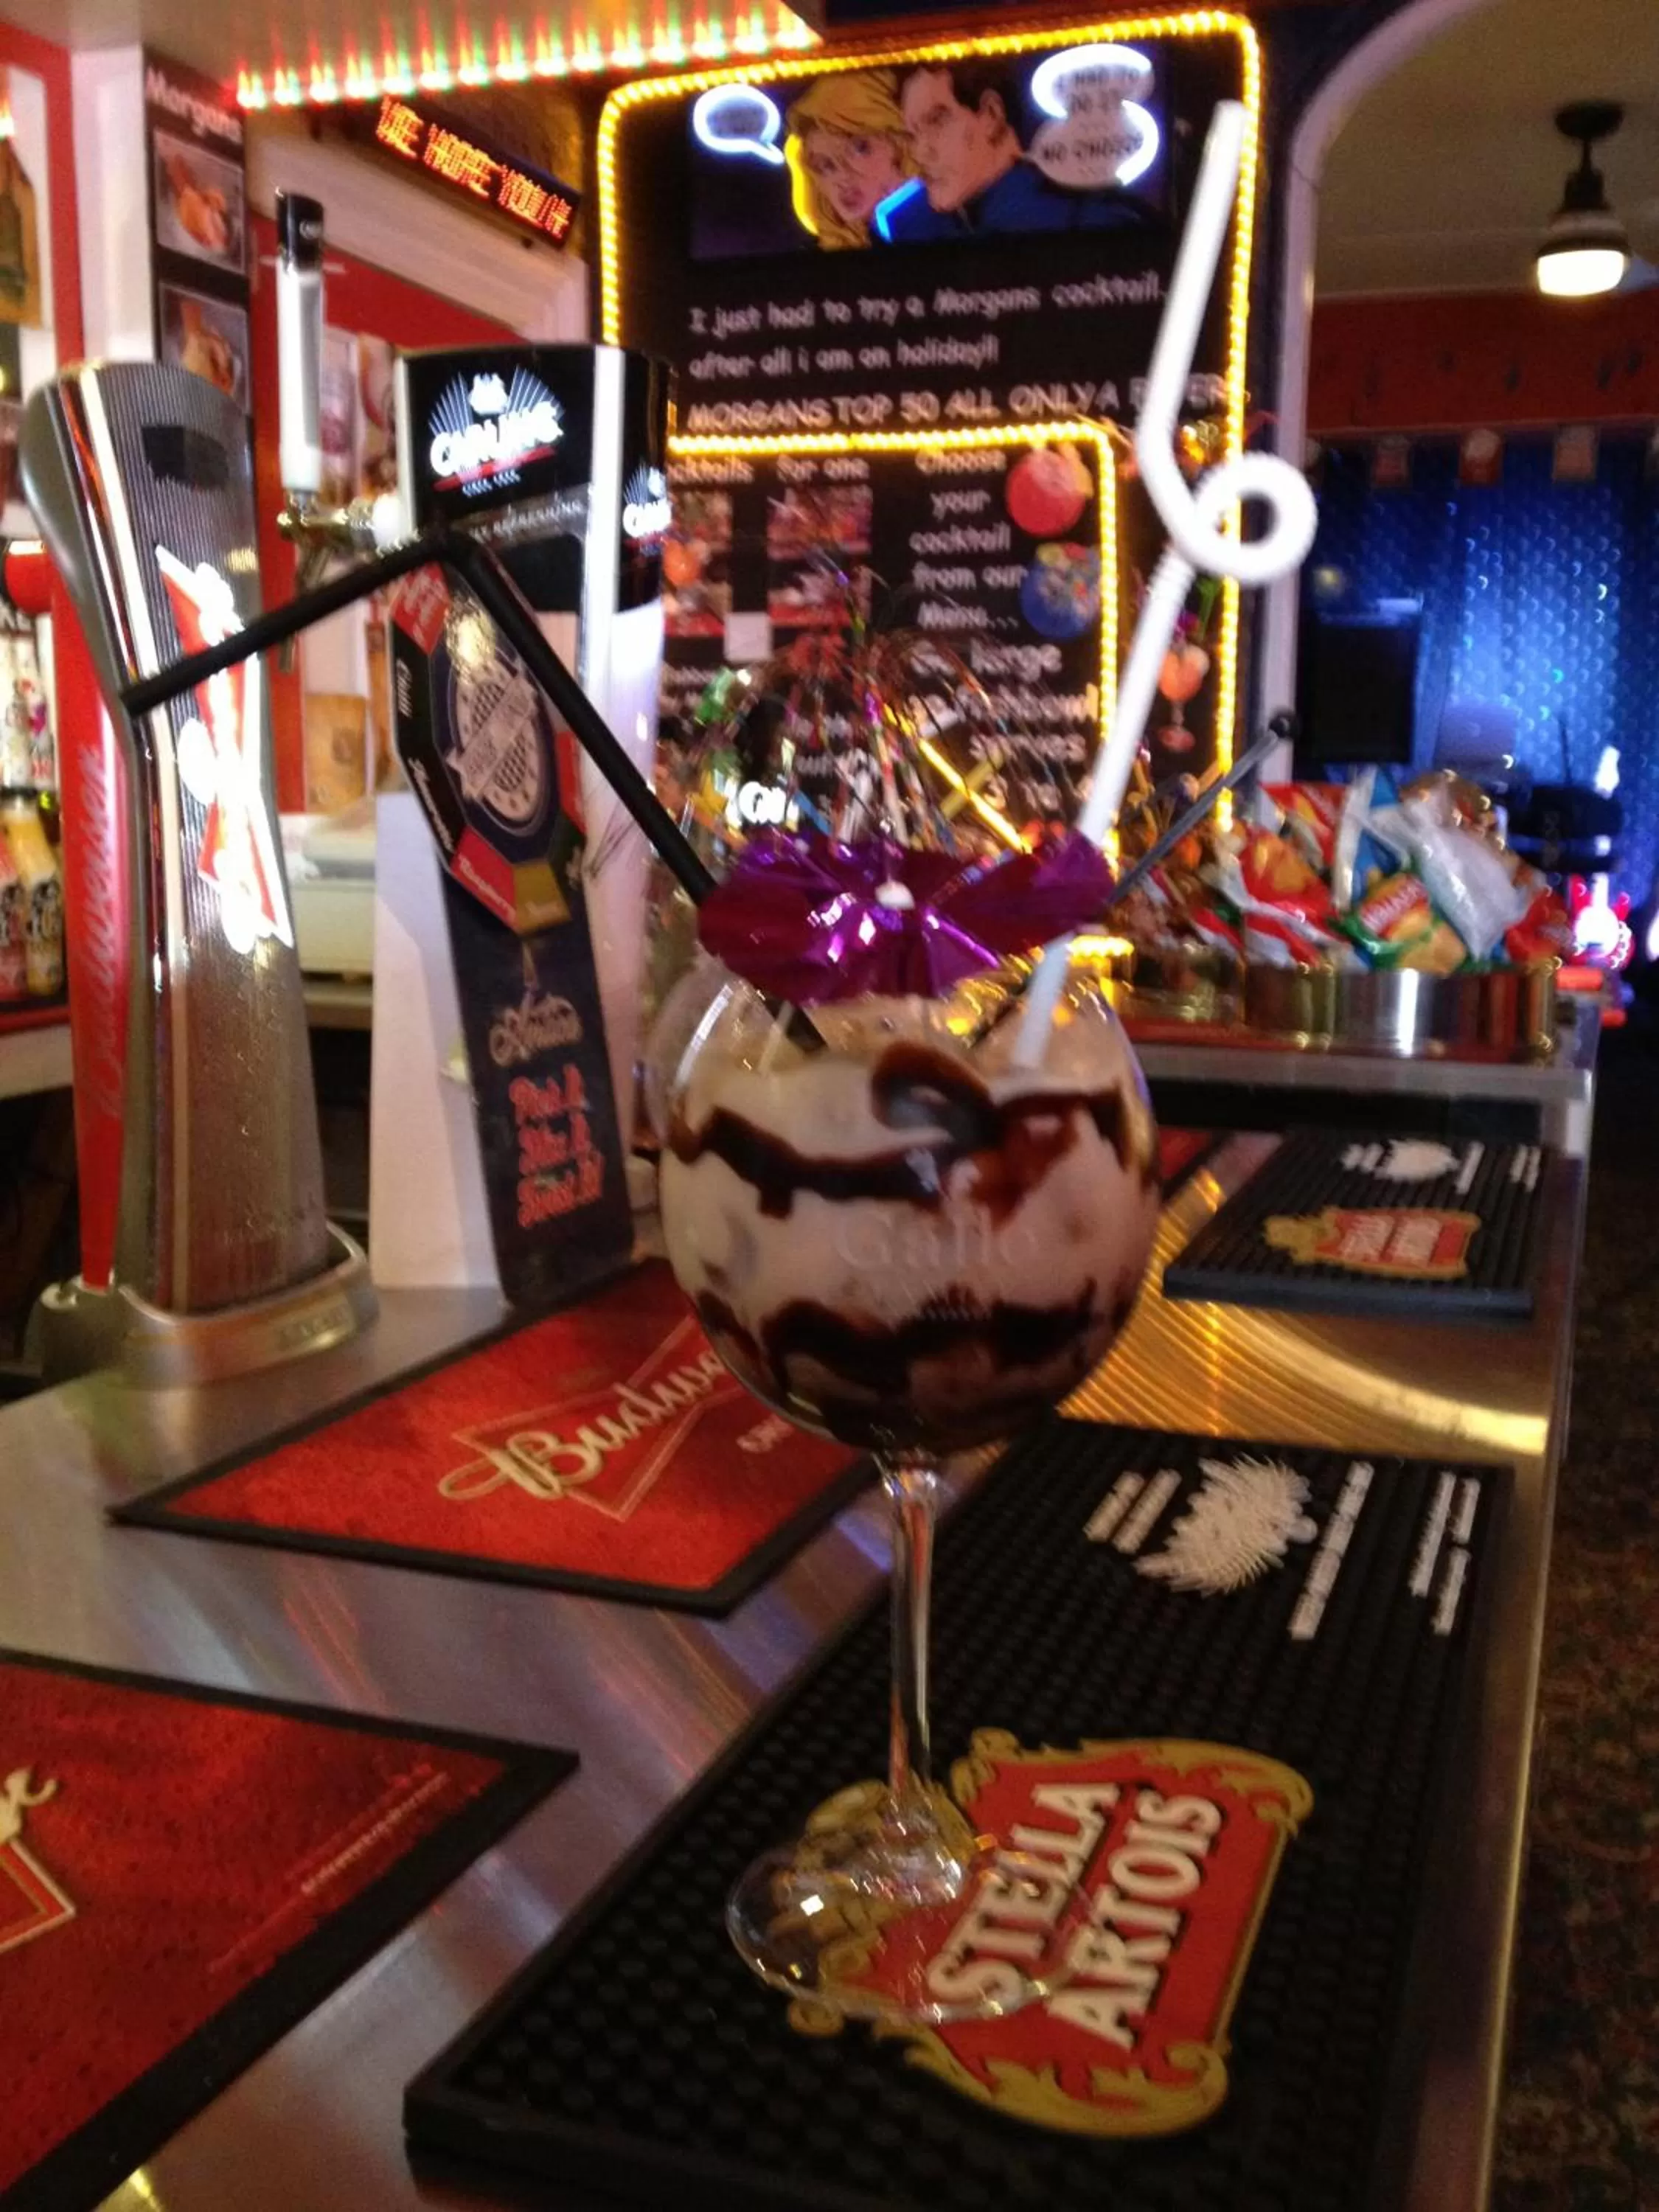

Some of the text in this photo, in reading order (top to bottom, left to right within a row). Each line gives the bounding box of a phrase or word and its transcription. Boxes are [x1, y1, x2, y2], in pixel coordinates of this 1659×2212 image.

[712, 303, 762, 341] just
[768, 298, 815, 330] had
[822, 298, 852, 324] to
[857, 295, 900, 327] try
[905, 295, 925, 318] a
[689, 350, 755, 380] after
[759, 344, 793, 377] all
[815, 349, 854, 371] am
[687, 398, 833, 432] MORGANS
[832, 392, 894, 425] TOP
[899, 389, 941, 422] 50
[944, 386, 1001, 420] ALL
[1008, 380, 1097, 417] ONLY
[930, 490, 992, 521] your
[909, 521, 1011, 553] cocktail
[912, 560, 1029, 592] from our
[437, 1348, 727, 1500] Budwe
[925, 1781, 1123, 2007] STELLA
[1046, 1787, 1225, 2051] ARTOIS
